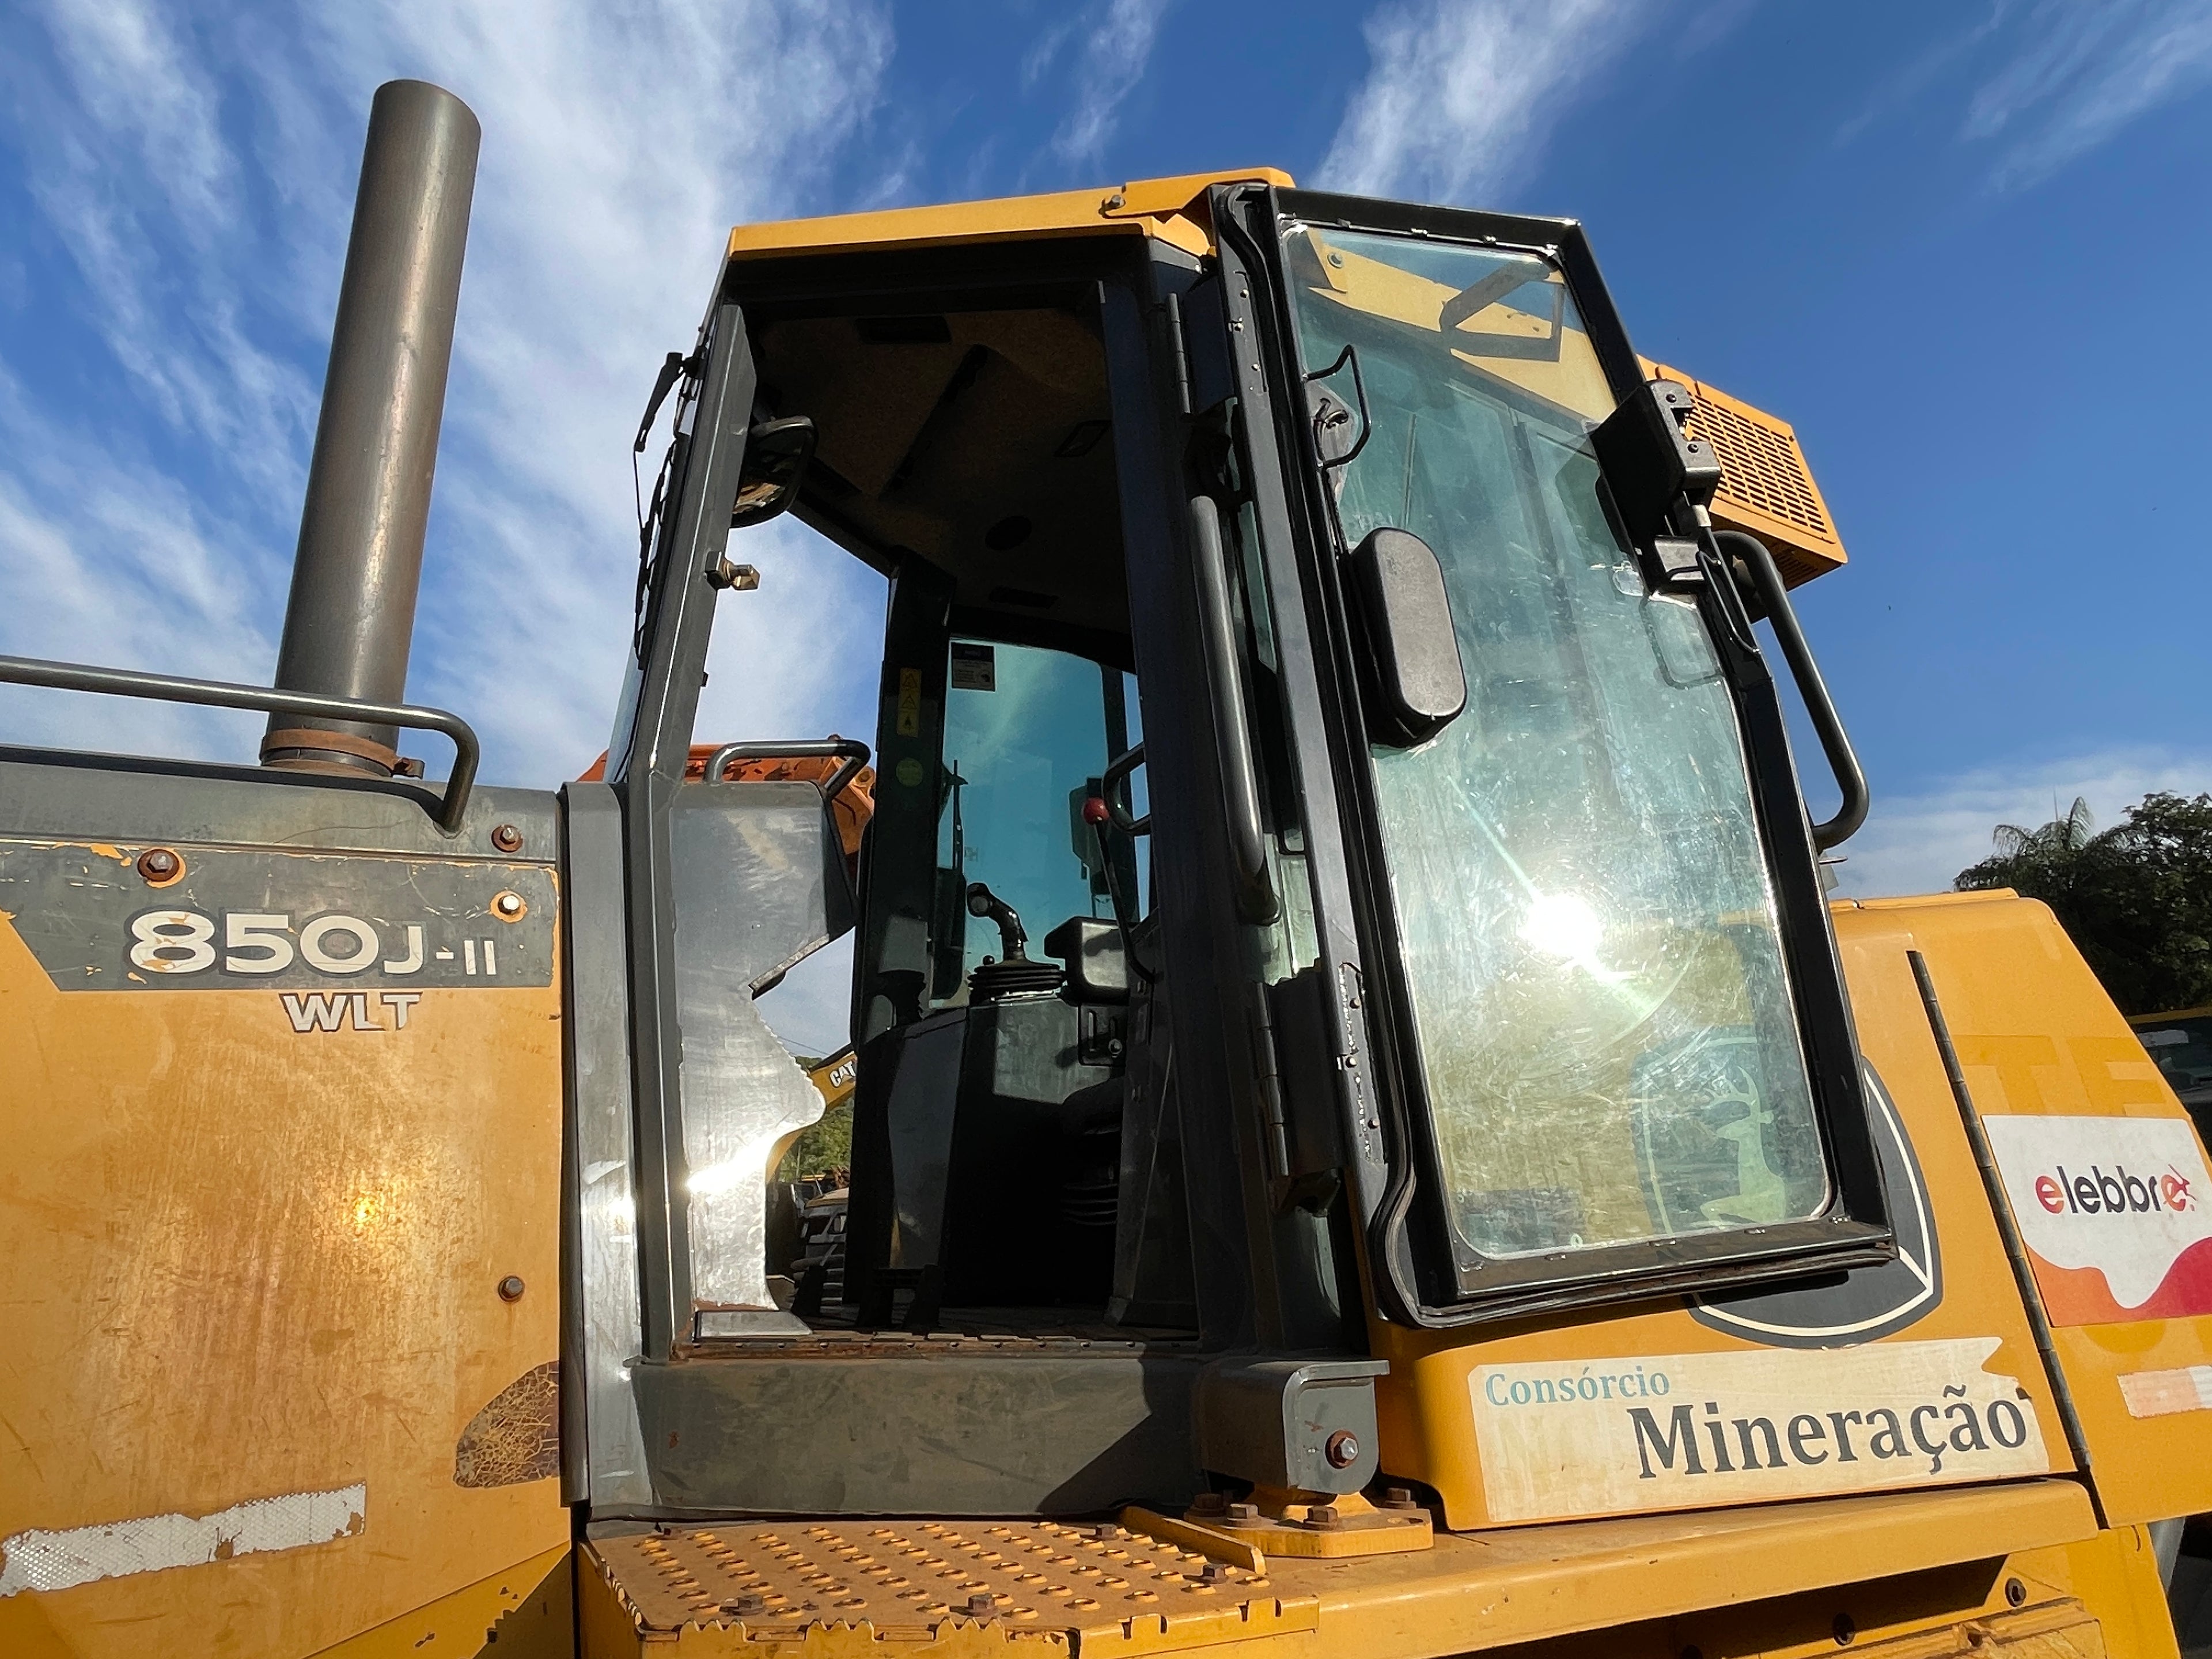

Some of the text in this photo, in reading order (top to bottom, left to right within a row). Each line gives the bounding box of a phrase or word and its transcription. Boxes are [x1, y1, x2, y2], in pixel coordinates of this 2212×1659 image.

[129, 911, 497, 976] 850J-II
[281, 992, 423, 1032] WLT
[830, 1060, 856, 1087] CAT
[1486, 1366, 1670, 1406] Consórcio
[1628, 1385, 2027, 1479] Mineração
